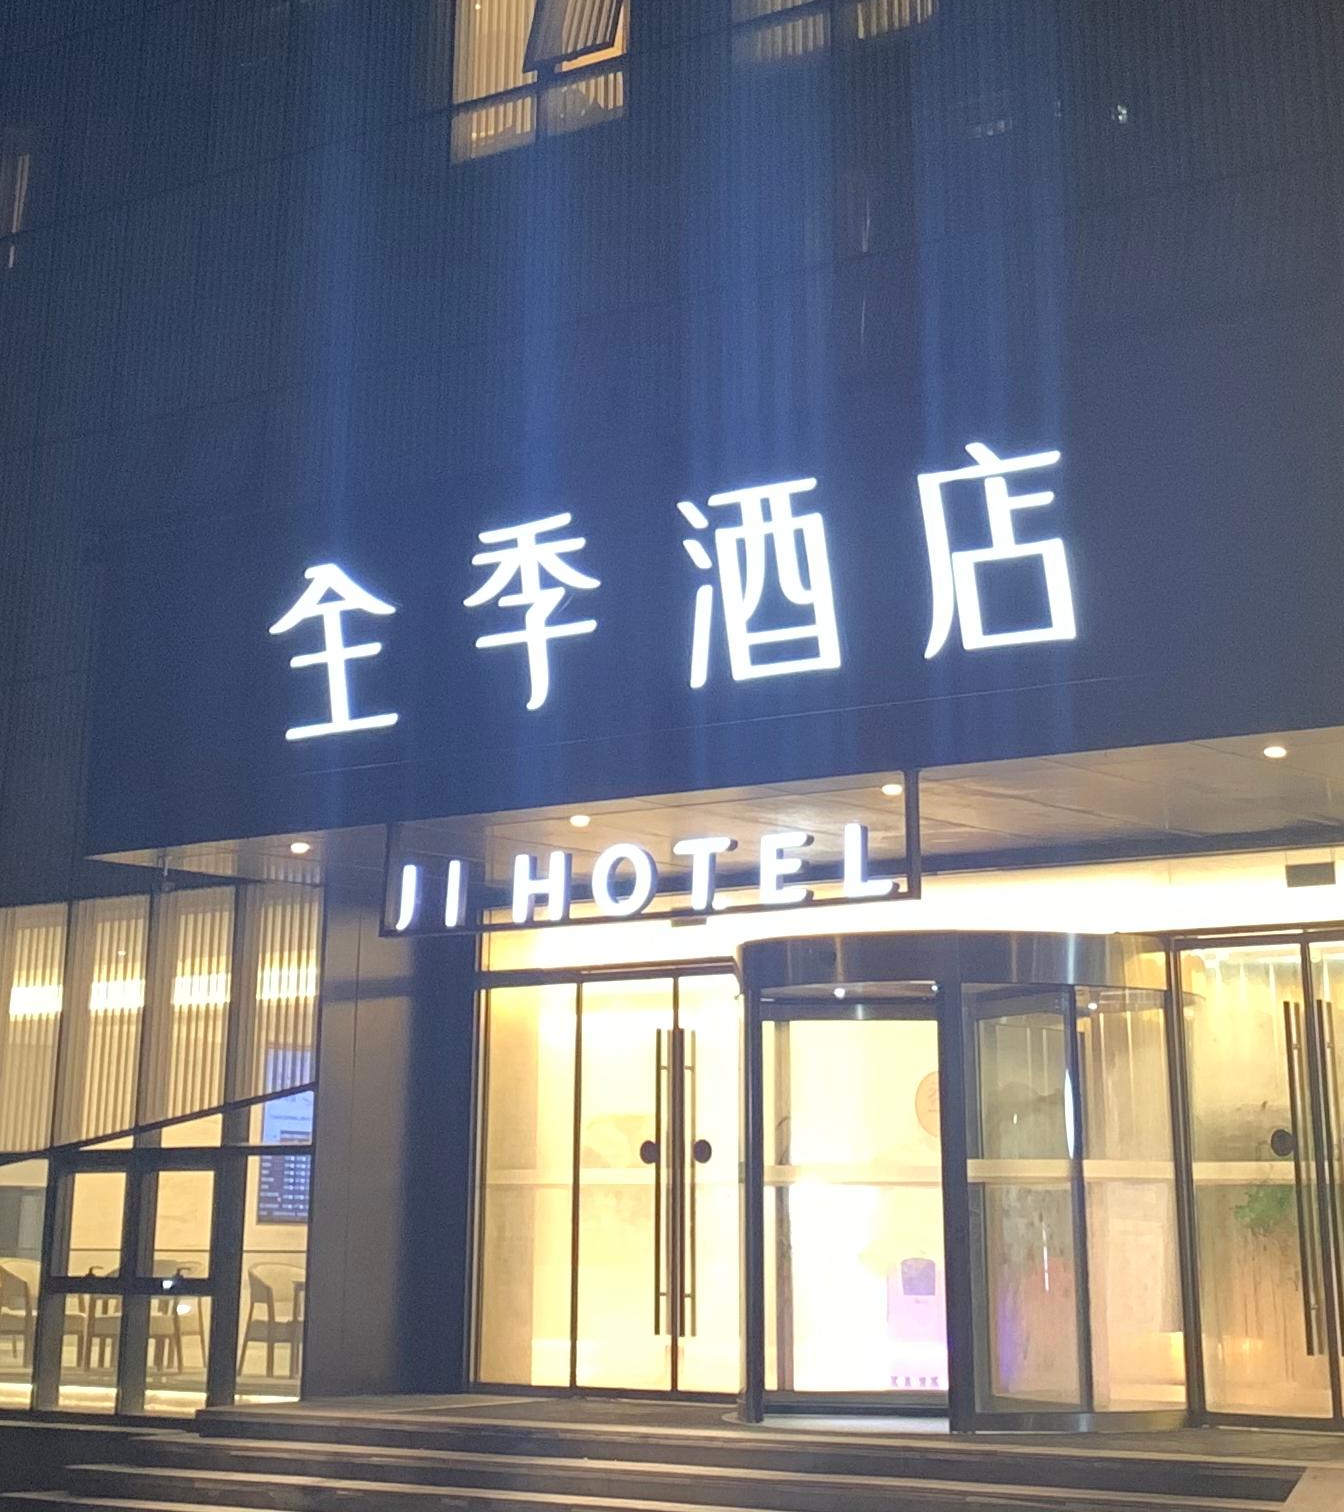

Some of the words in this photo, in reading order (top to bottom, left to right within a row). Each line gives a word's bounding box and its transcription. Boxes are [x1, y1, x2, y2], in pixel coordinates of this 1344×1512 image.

[268, 441, 1078, 740] 全季酒店
[396, 859, 467, 930] JI
[512, 823, 897, 924] HOTEL
